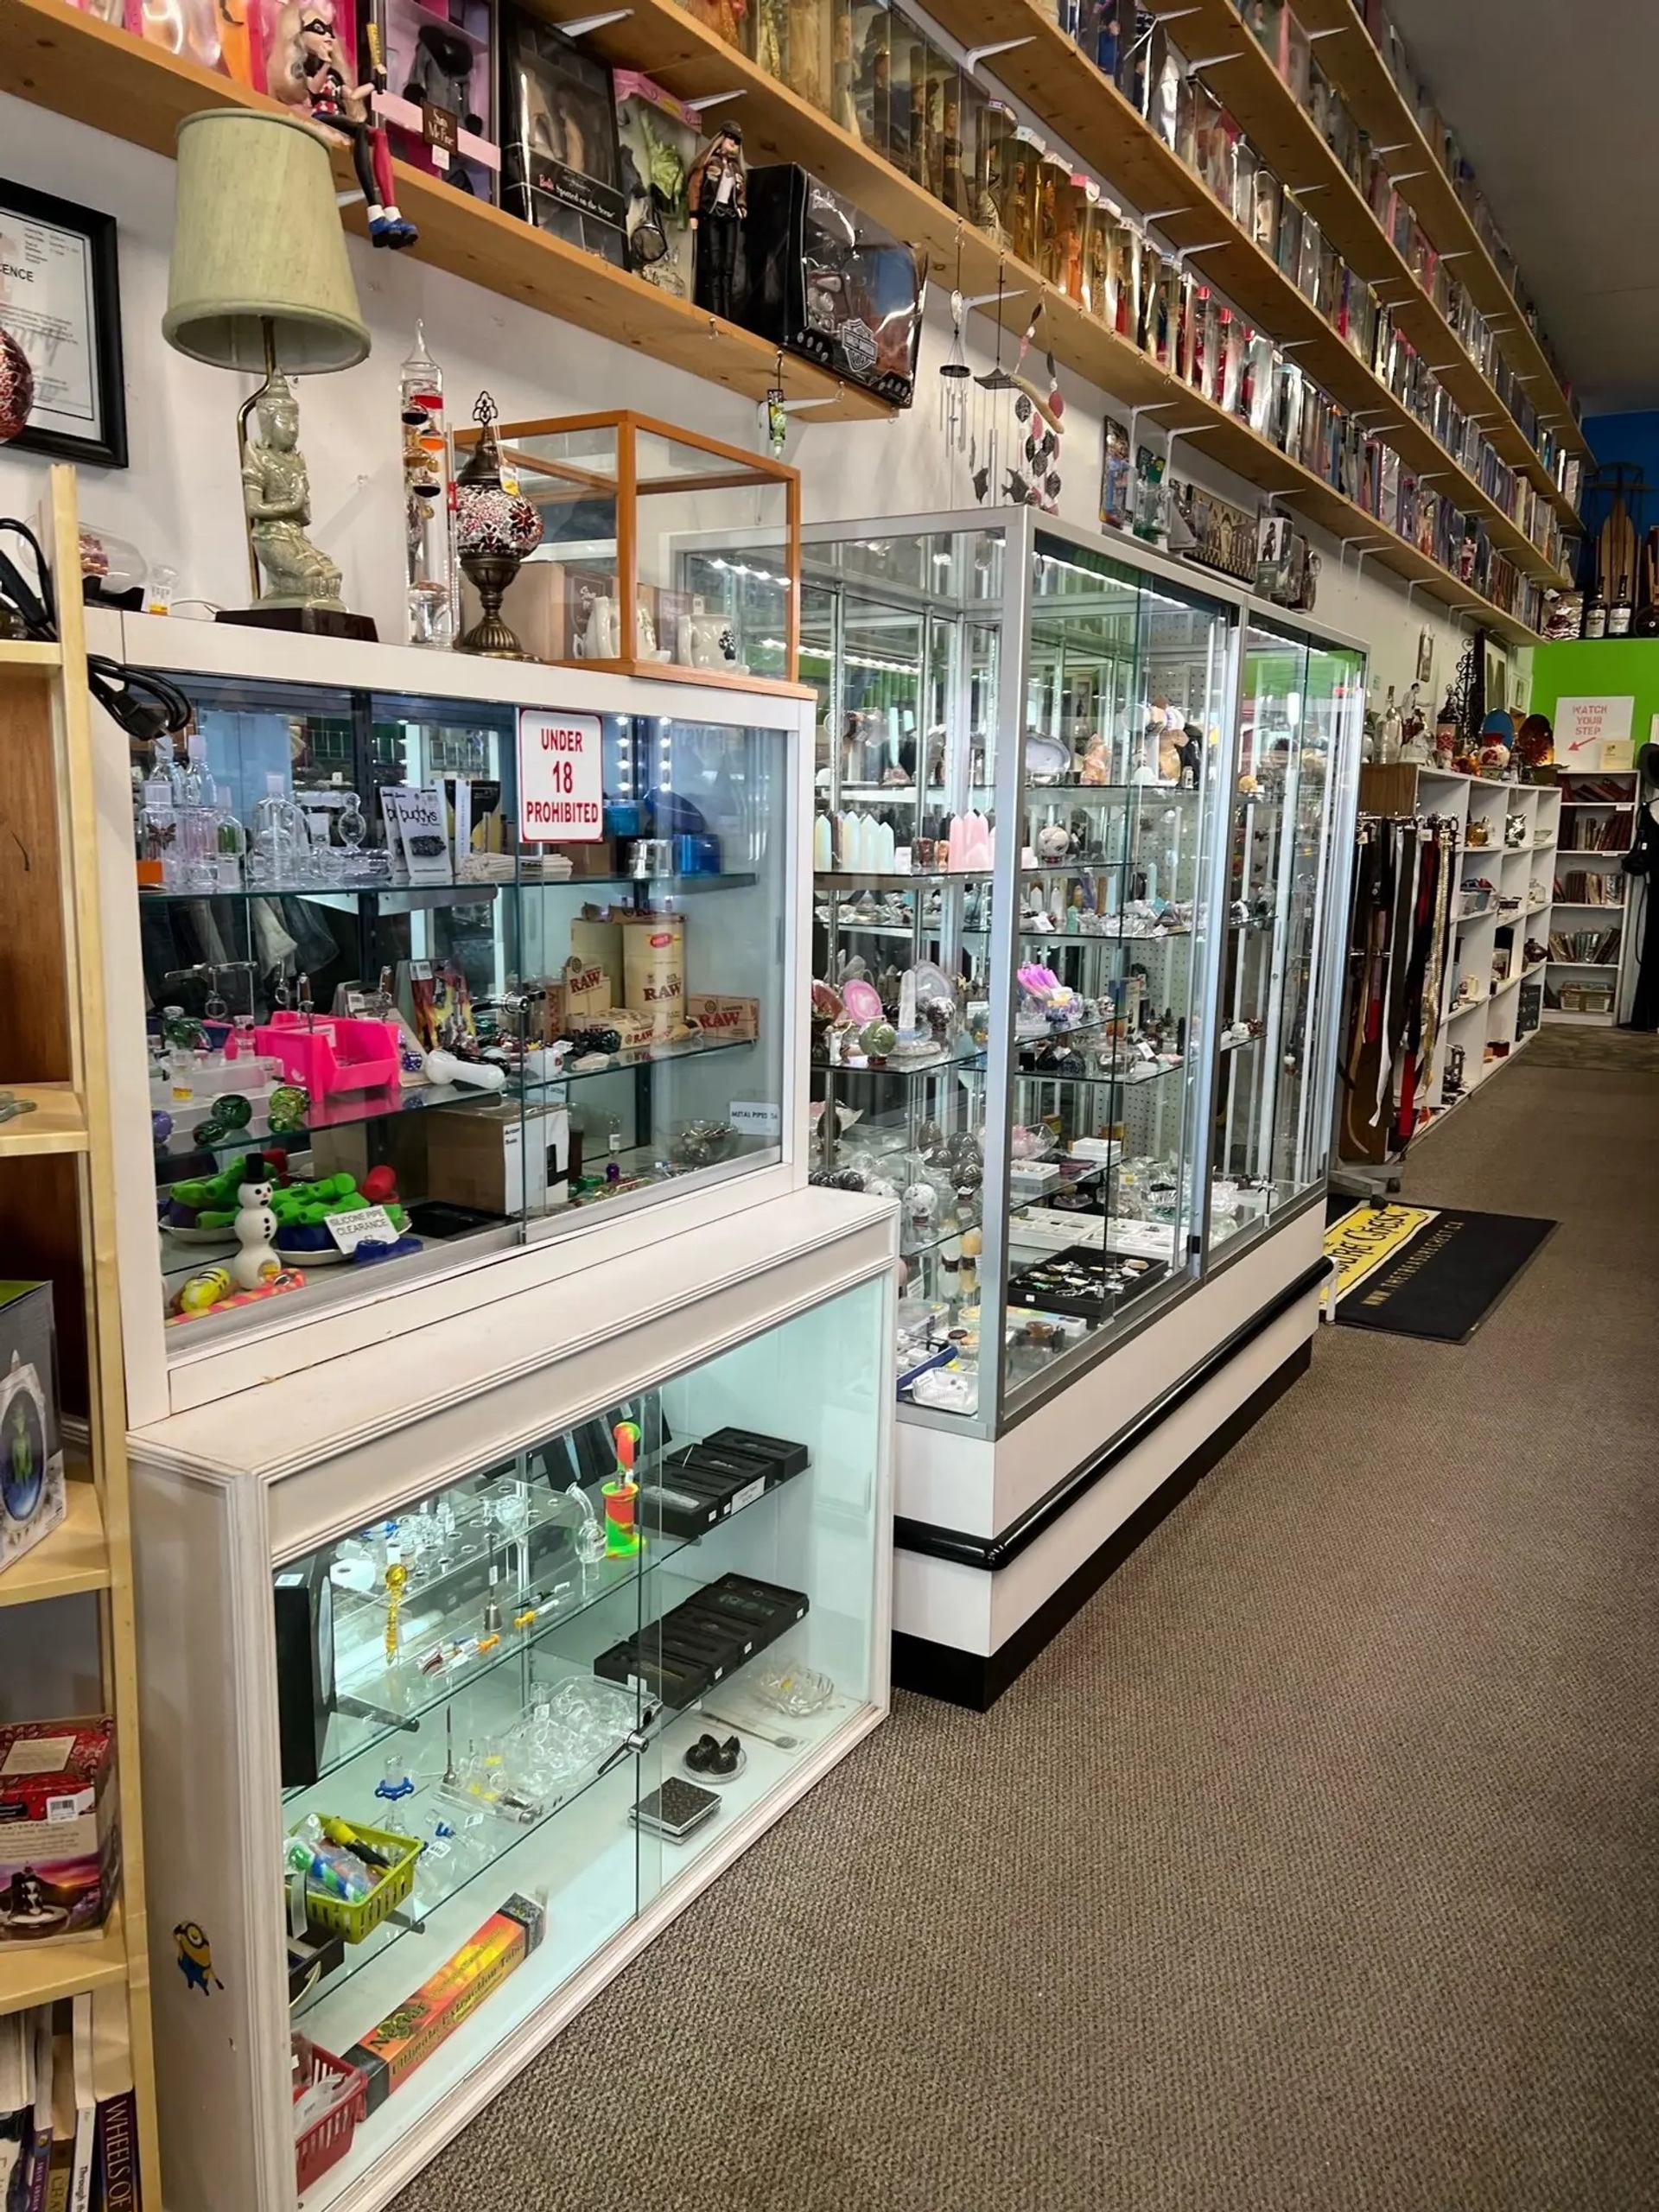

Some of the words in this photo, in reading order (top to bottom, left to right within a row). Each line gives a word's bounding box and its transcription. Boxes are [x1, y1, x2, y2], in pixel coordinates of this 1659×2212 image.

[0, 264, 34, 283] ENCE
[1573, 705, 1607, 714] WATCH
[541, 728, 582, 753] UNDER
[1575, 727, 1600, 735] STEP
[552, 760, 573, 793] 18
[526, 801, 599, 823] PROHIBITED
[569, 970, 602, 994] RAW
[643, 982, 682, 1001] RAW
[699, 1011, 741, 1028] RAW
[633, 1029, 655, 1044] RAW
[329, 1211, 366, 1226] SILICONE
[336, 1218, 390, 1236] CLEARANCE
[105, 2099, 131, 2180] WHEELS
[75, 2165, 88, 2202] Through
[108, 2181, 132, 2208] OF
